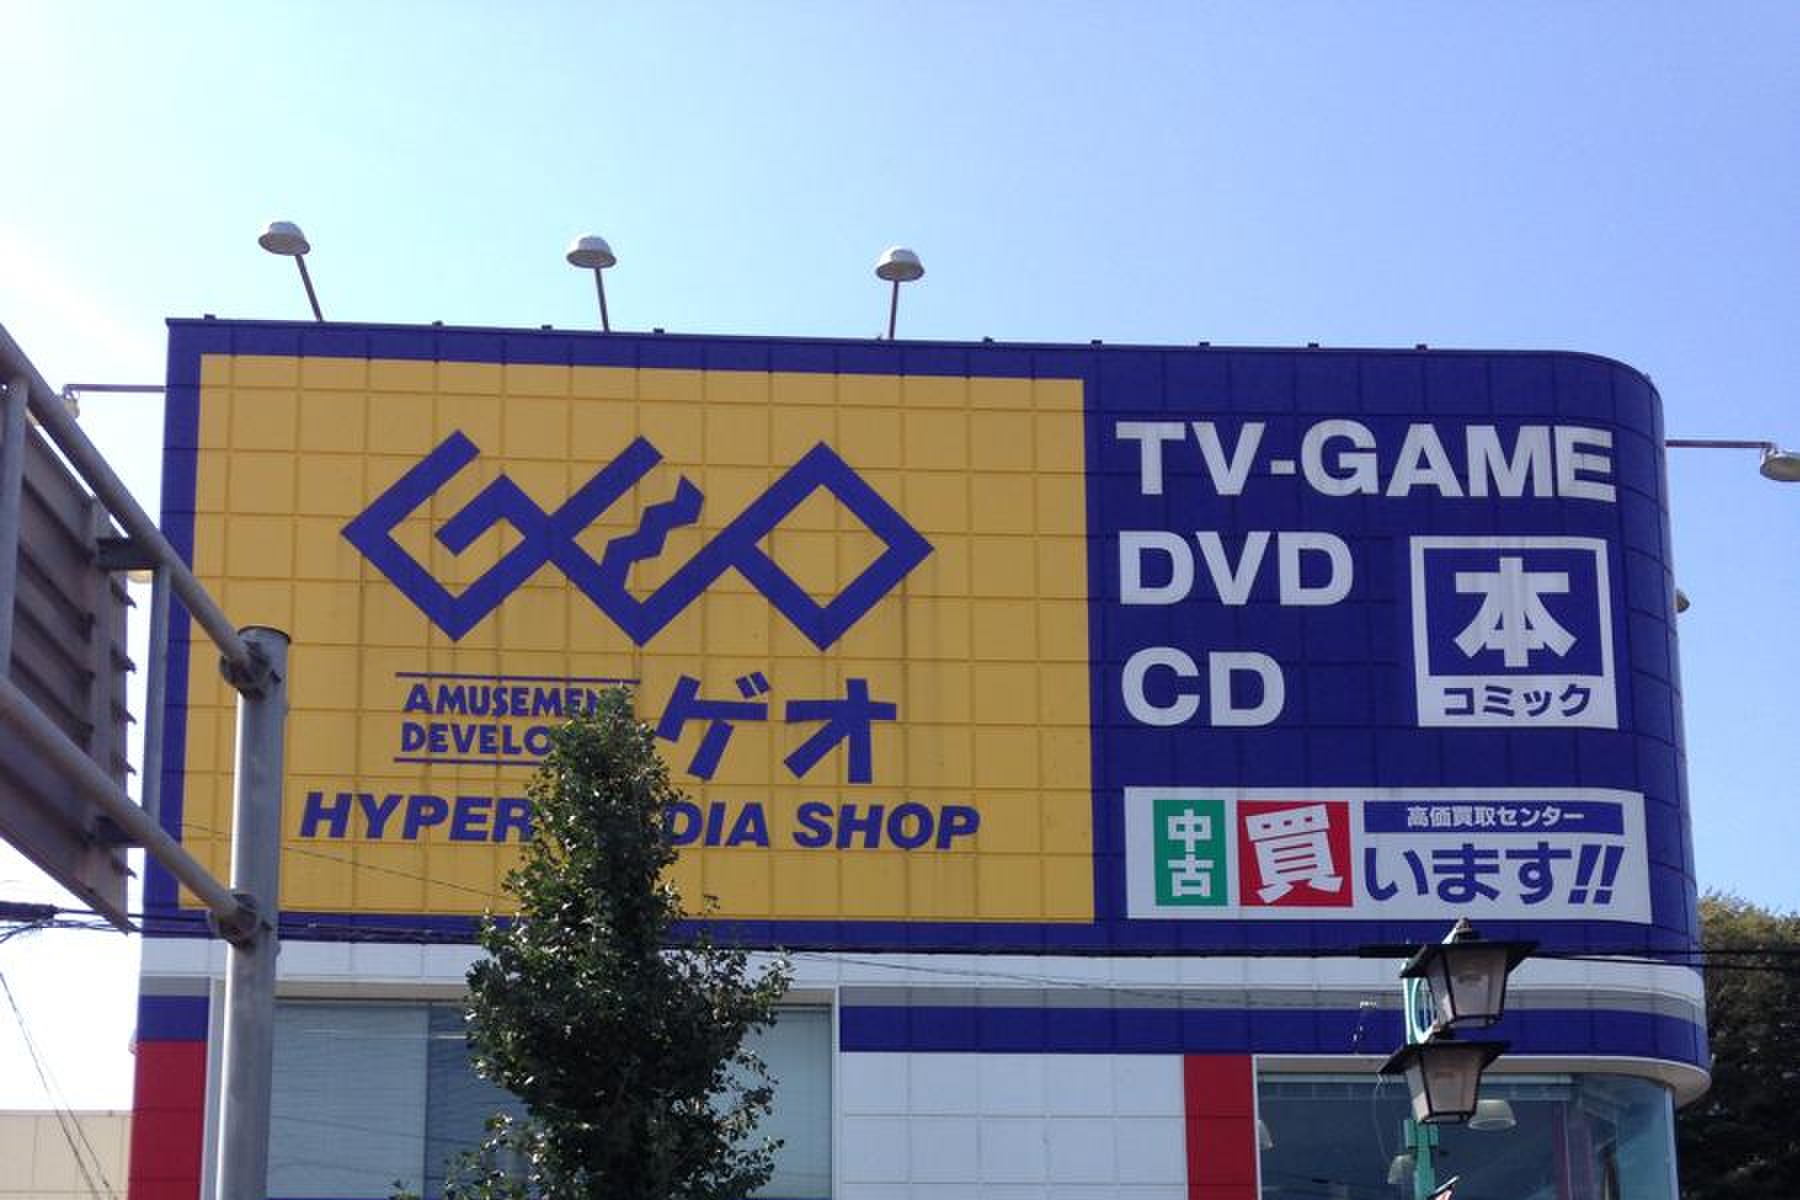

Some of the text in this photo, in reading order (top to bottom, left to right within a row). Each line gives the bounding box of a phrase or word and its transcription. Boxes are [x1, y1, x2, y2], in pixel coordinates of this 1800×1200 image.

[1116, 419, 1617, 502] TV-GAME
[341, 429, 935, 652] GEO
[1119, 530, 1354, 606] DVD
[1454, 557, 1577, 667] 本
[655, 672, 896, 784] ゲオ
[1121, 646, 1285, 727] CD
[1443, 683, 1591, 717] コミック
[299, 791, 534, 842] HYPER
[792, 802, 981, 850] SHOP
[1167, 808, 1212, 898] 中古
[1245, 803, 1344, 905] 買
[1406, 804, 1585, 829] 高価買取センター
